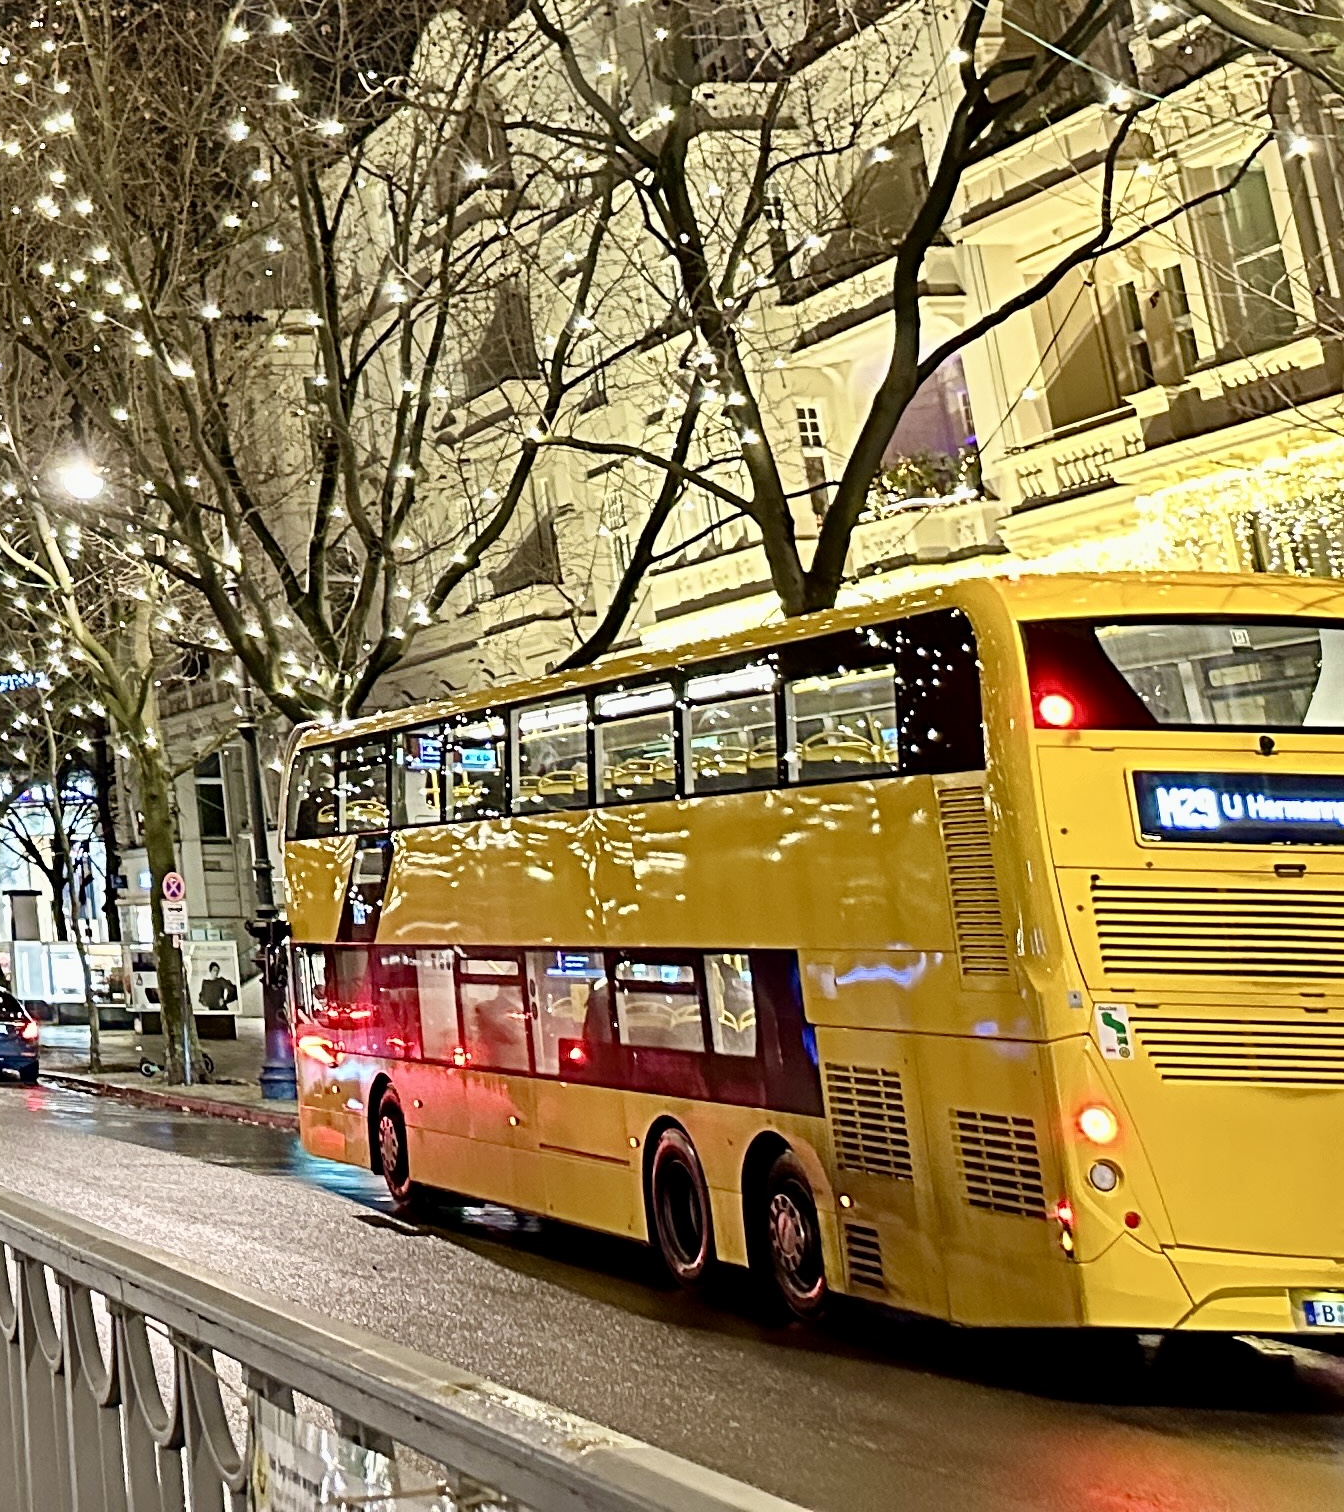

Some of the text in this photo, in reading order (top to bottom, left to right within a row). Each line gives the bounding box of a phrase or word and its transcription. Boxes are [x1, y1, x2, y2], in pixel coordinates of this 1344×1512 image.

[1156, 787, 1220, 829] M29
[1221, 793, 1243, 818] U
[1321, 1304, 1336, 1323] B
